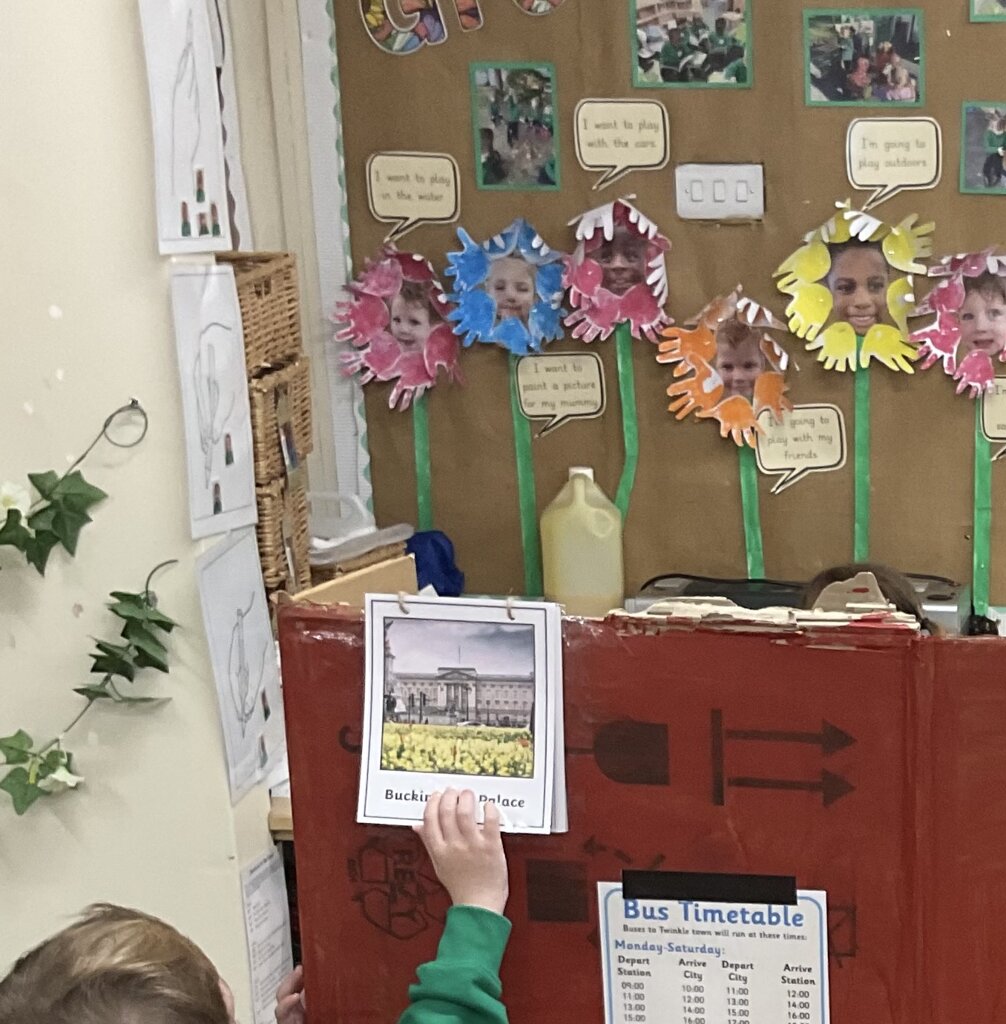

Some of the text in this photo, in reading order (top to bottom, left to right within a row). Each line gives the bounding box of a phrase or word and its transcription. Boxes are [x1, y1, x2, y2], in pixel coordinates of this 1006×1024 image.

[820, 415, 830, 425] to
[623, 899, 804, 927] Bus Timetable
[623, 924, 646, 934] Buses
[648, 926, 657, 934] to
[659, 926, 689, 936] Twinkle
[692, 928, 712, 936] town
[759, 931, 781, 940] these
[618, 955, 813, 974] Depart Arrive Depart Arrive
[617, 967, 816, 986] Station City City Station
